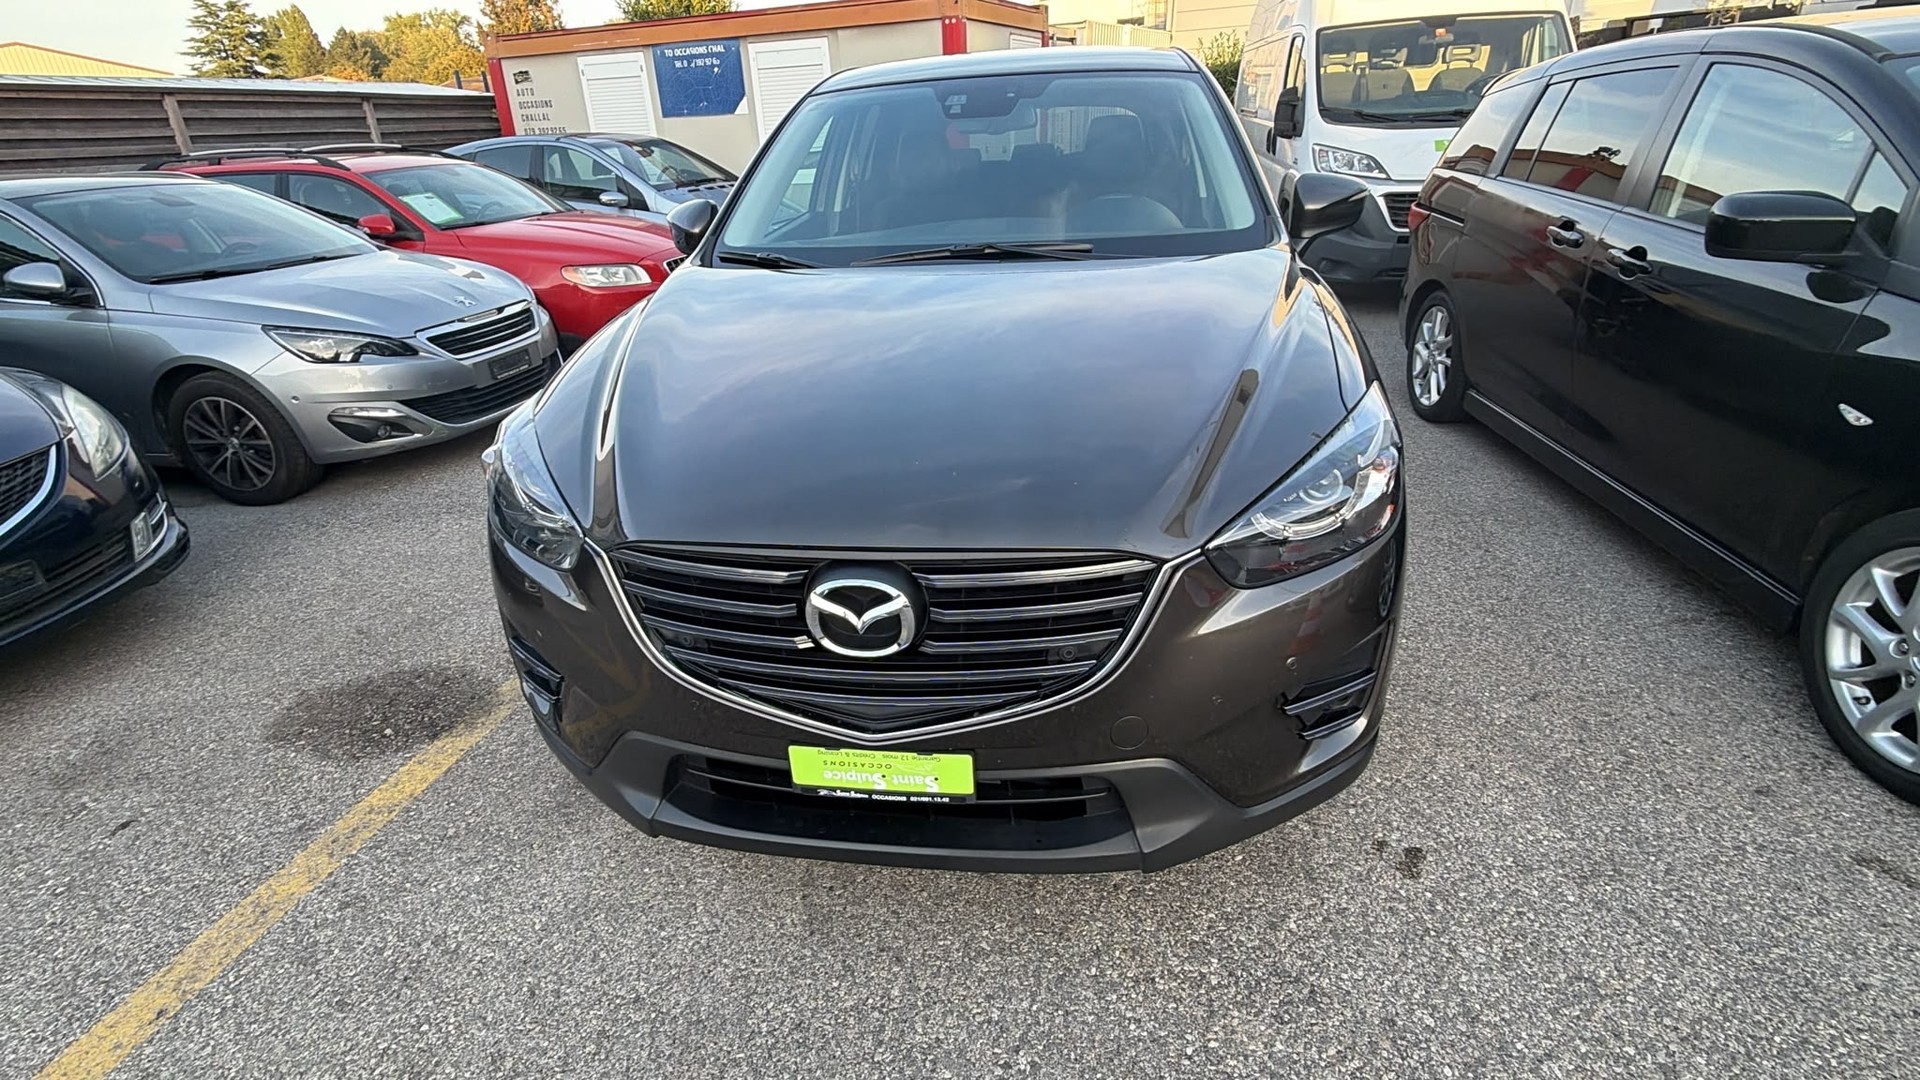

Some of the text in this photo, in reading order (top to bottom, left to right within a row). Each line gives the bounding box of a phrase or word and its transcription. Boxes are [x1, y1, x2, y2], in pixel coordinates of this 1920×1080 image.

[674, 46, 707, 56] OCCASIONS
[516, 87, 535, 97] AUTO
[518, 99, 553, 110] OCCASIONS
[521, 112, 551, 122] CHALLAL
[822, 759, 893, 770] OCCASIONS
